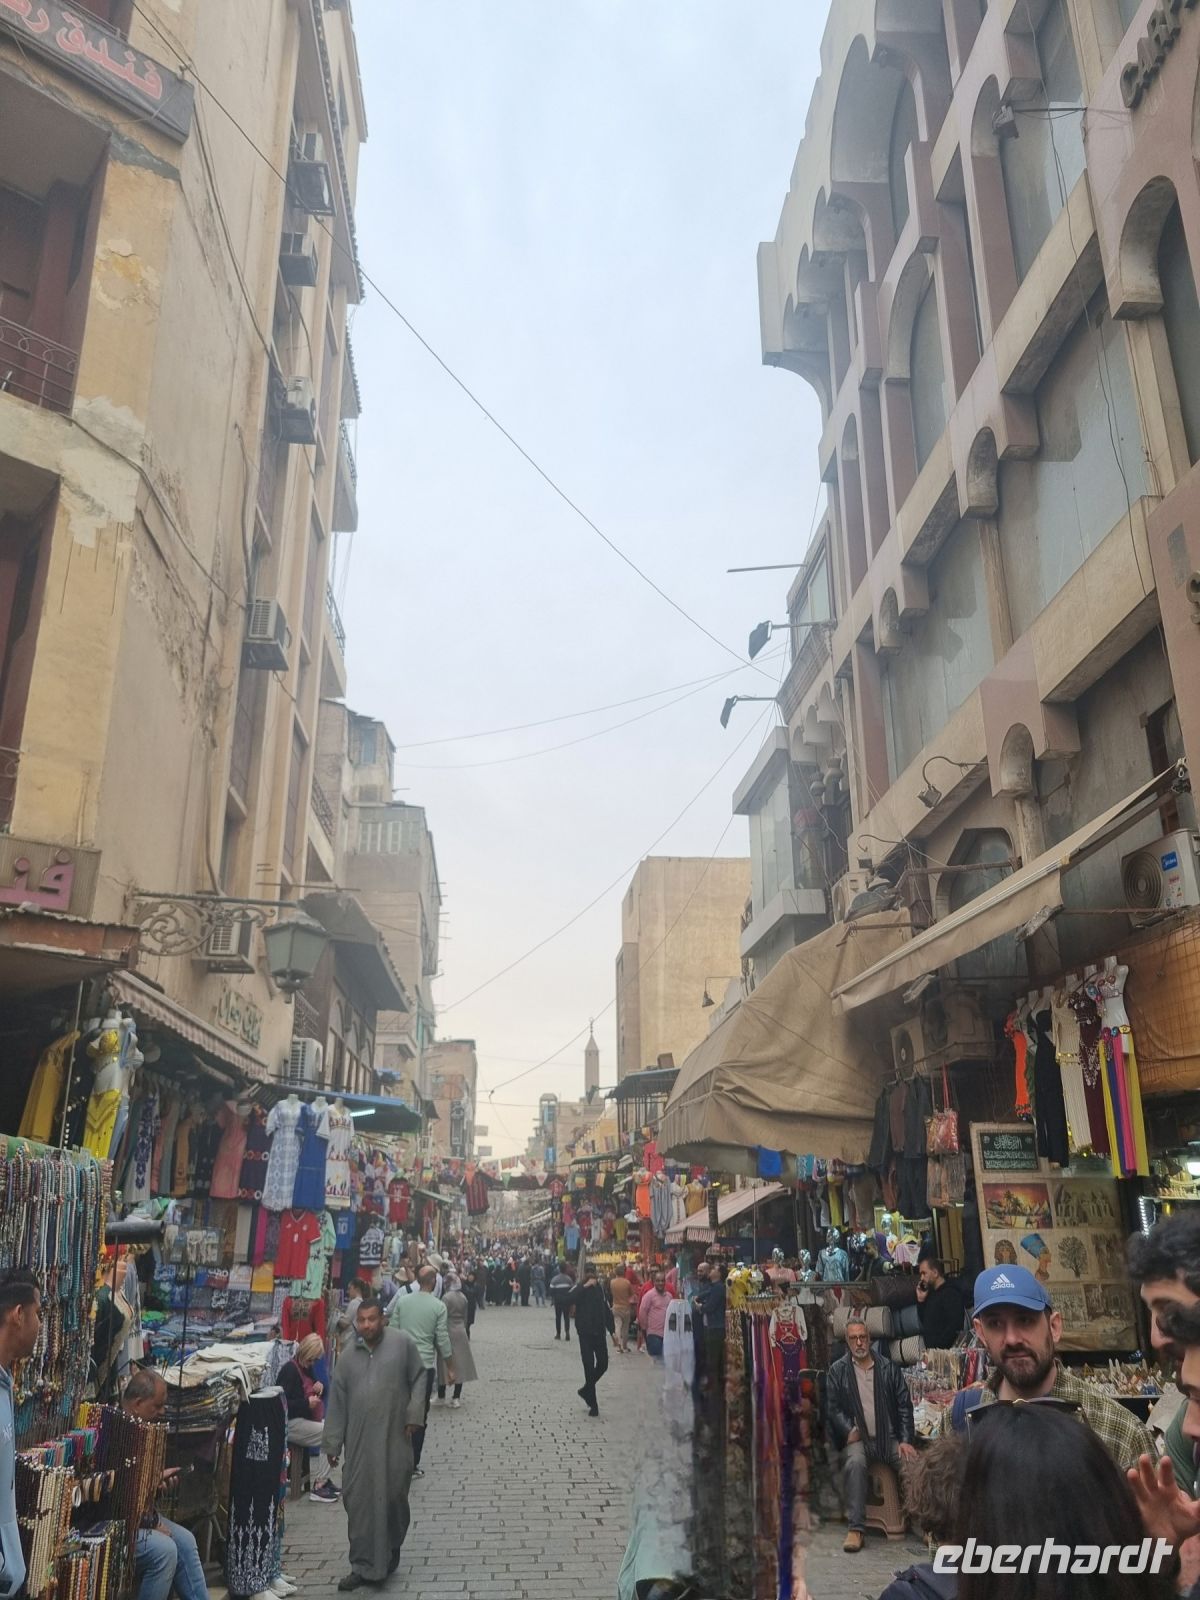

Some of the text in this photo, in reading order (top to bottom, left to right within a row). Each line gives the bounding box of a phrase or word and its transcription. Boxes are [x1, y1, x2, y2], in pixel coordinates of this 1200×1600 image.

[55, 11, 163, 100] فندق
[0, 848, 76, 912] فن
[365, 1242, 379, 1256] 28
[991, 1282, 1015, 1291] adidas
